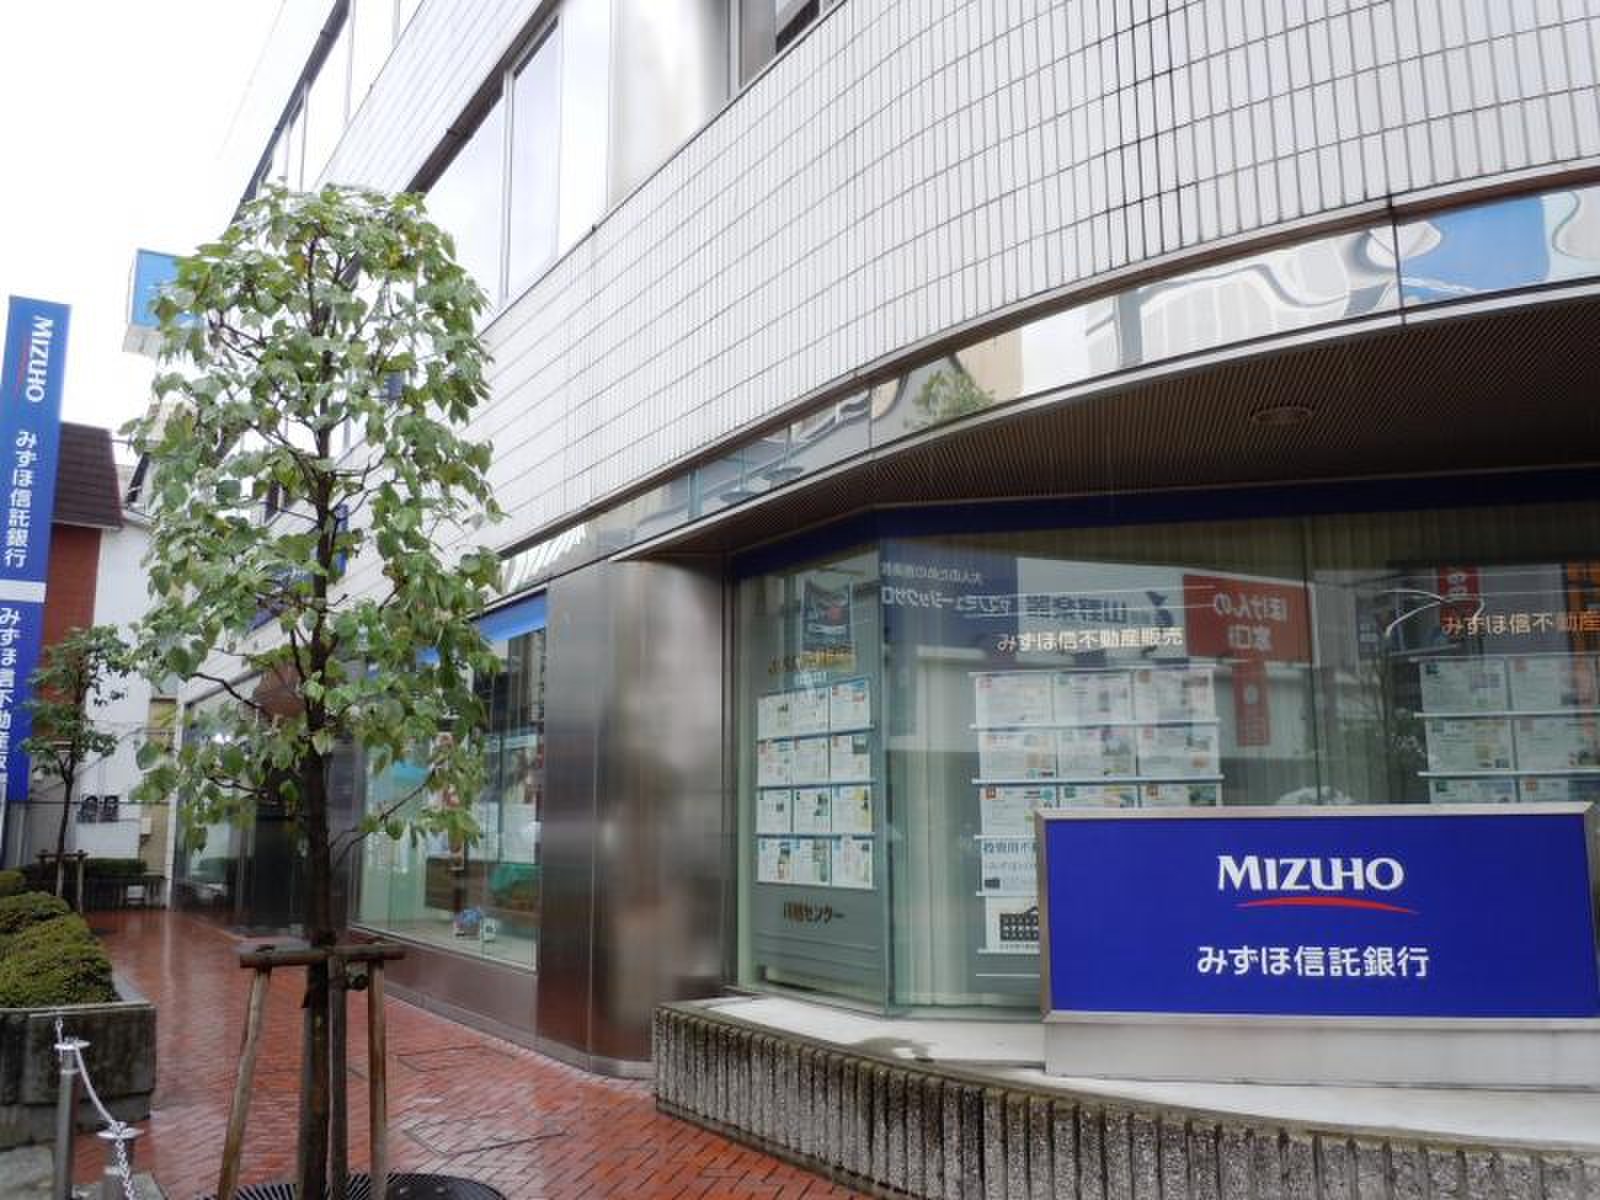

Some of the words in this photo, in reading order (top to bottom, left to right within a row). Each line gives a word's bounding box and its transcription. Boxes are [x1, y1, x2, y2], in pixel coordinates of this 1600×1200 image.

[25, 315, 54, 403] MIZUHO
[4, 430, 38, 569] みずほ信託銀行
[996, 627, 1184, 653] みずほ信不動産販売
[1217, 855, 1405, 892] MIZUHO
[1196, 945, 1430, 979] みずほ信託銀行
